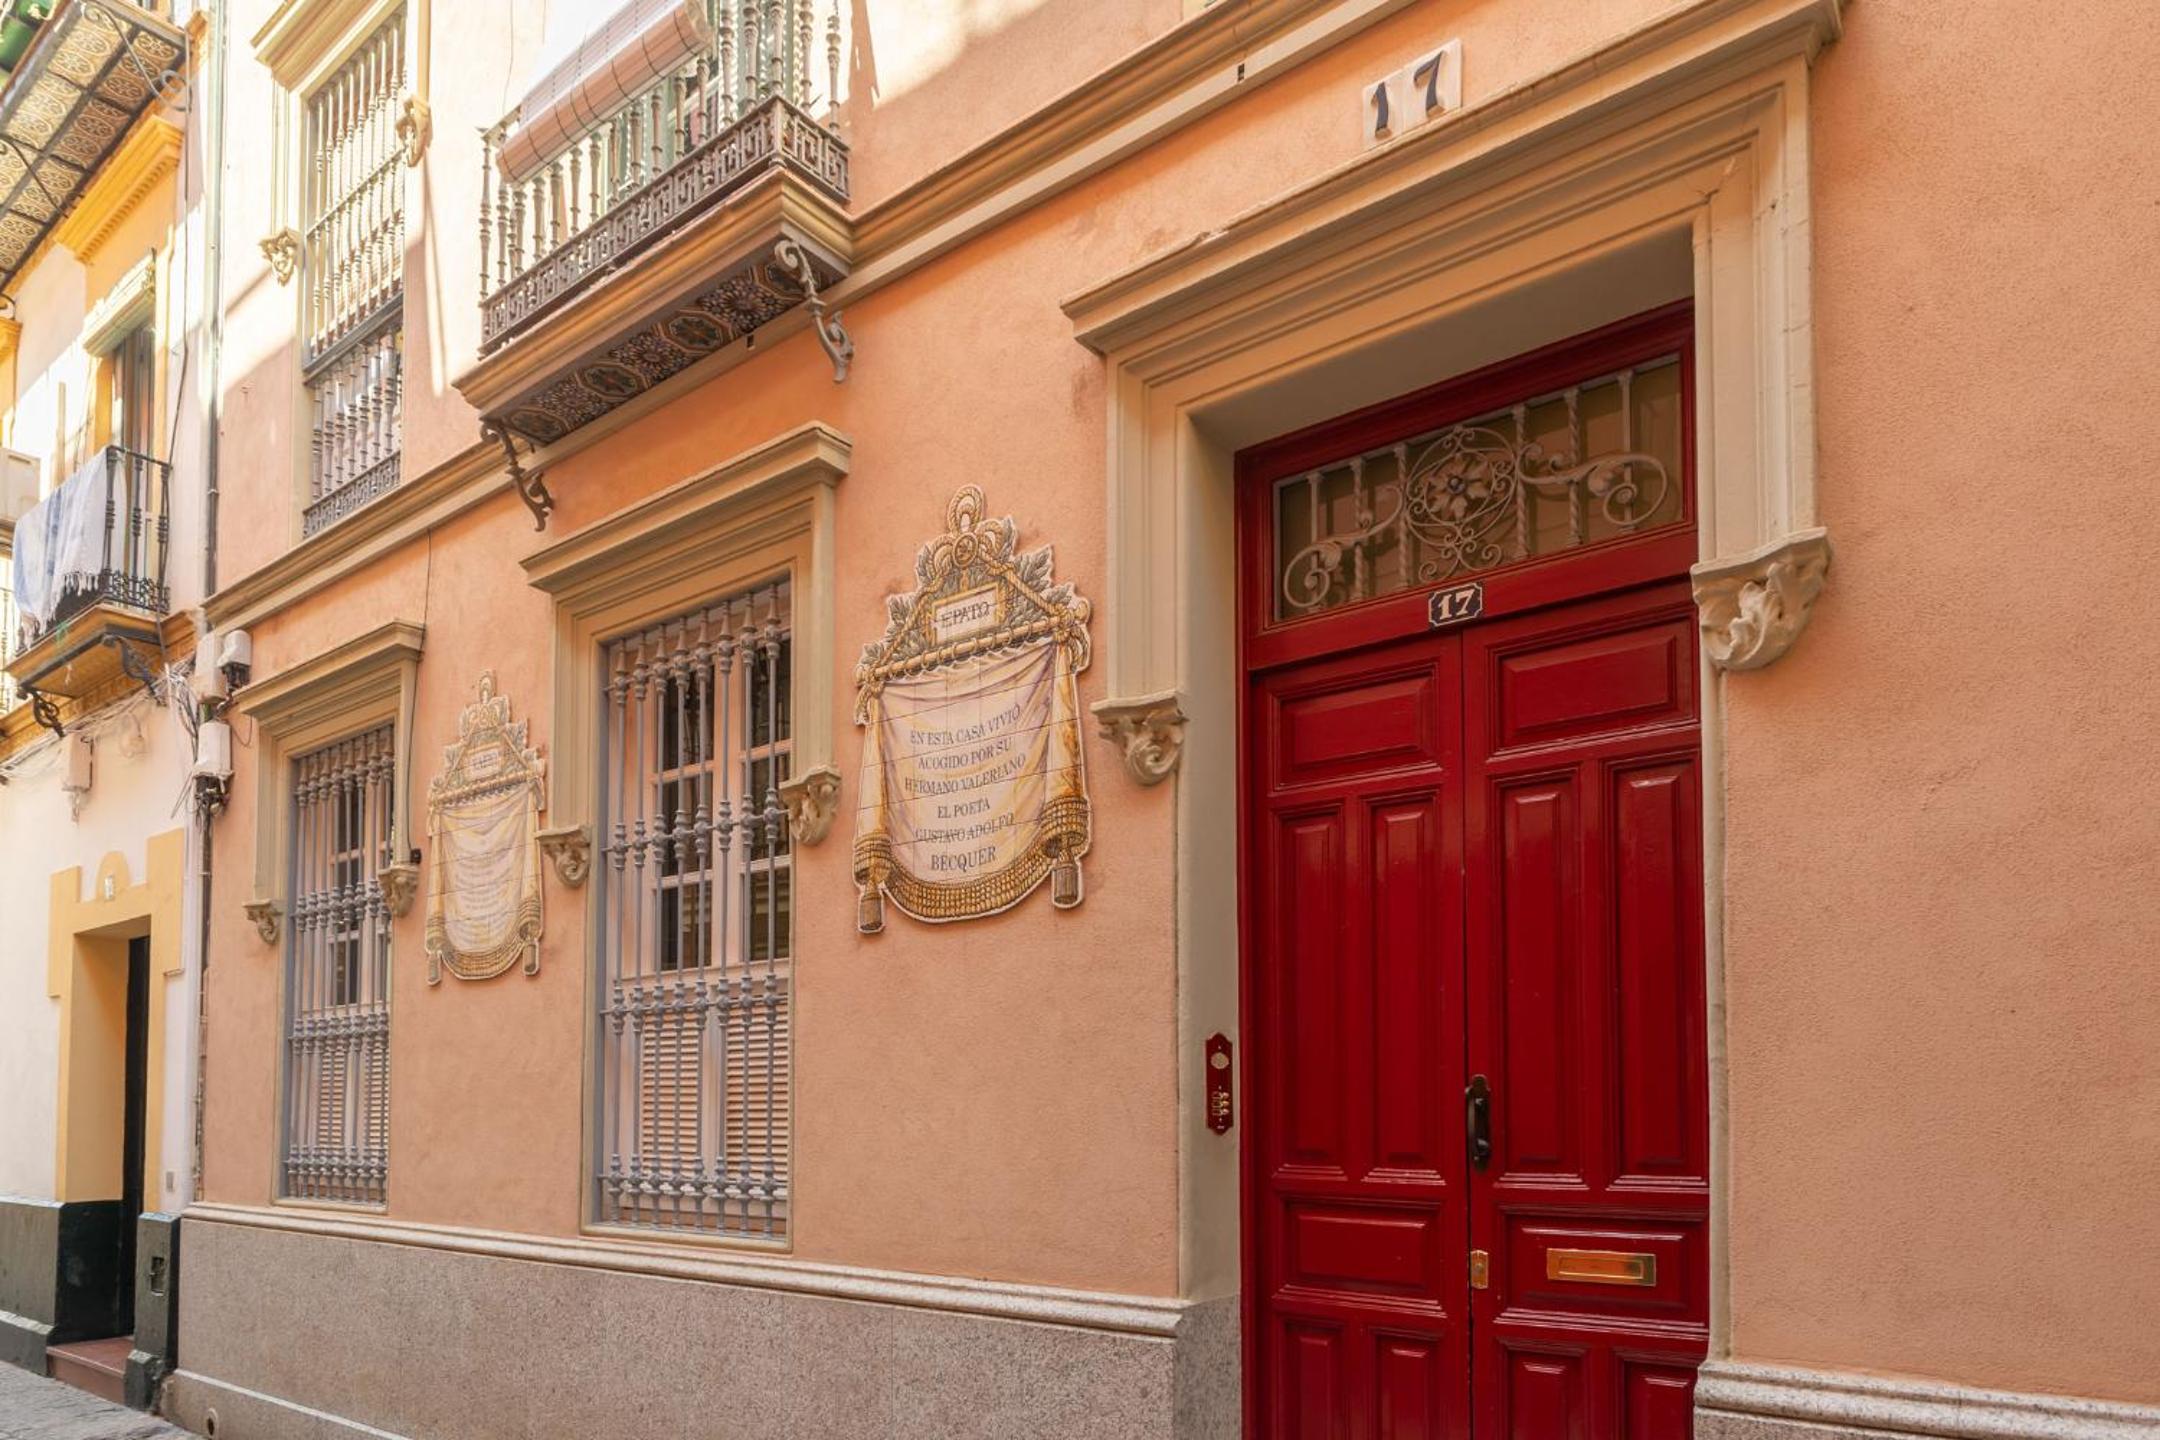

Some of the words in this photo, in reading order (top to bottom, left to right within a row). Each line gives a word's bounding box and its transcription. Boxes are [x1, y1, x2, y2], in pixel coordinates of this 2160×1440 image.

[1371, 49, 1446, 139] 17
[1438, 588, 1475, 620] 17
[910, 730, 925, 745] EN
[927, 730, 954, 746] ESTA
[956, 722, 985, 743] CASA
[918, 754, 969, 770] ACOGIDO
[971, 745, 994, 766] POR
[995, 736, 1013, 755] SU
[905, 776, 959, 796] HERMANO
[960, 753, 1026, 791] VALERIANO
[937, 806, 952, 819] EL
[954, 797, 991, 818] POETA
[915, 827, 966, 844] GUSTAVO
[967, 812, 1015, 841] ADOLFO
